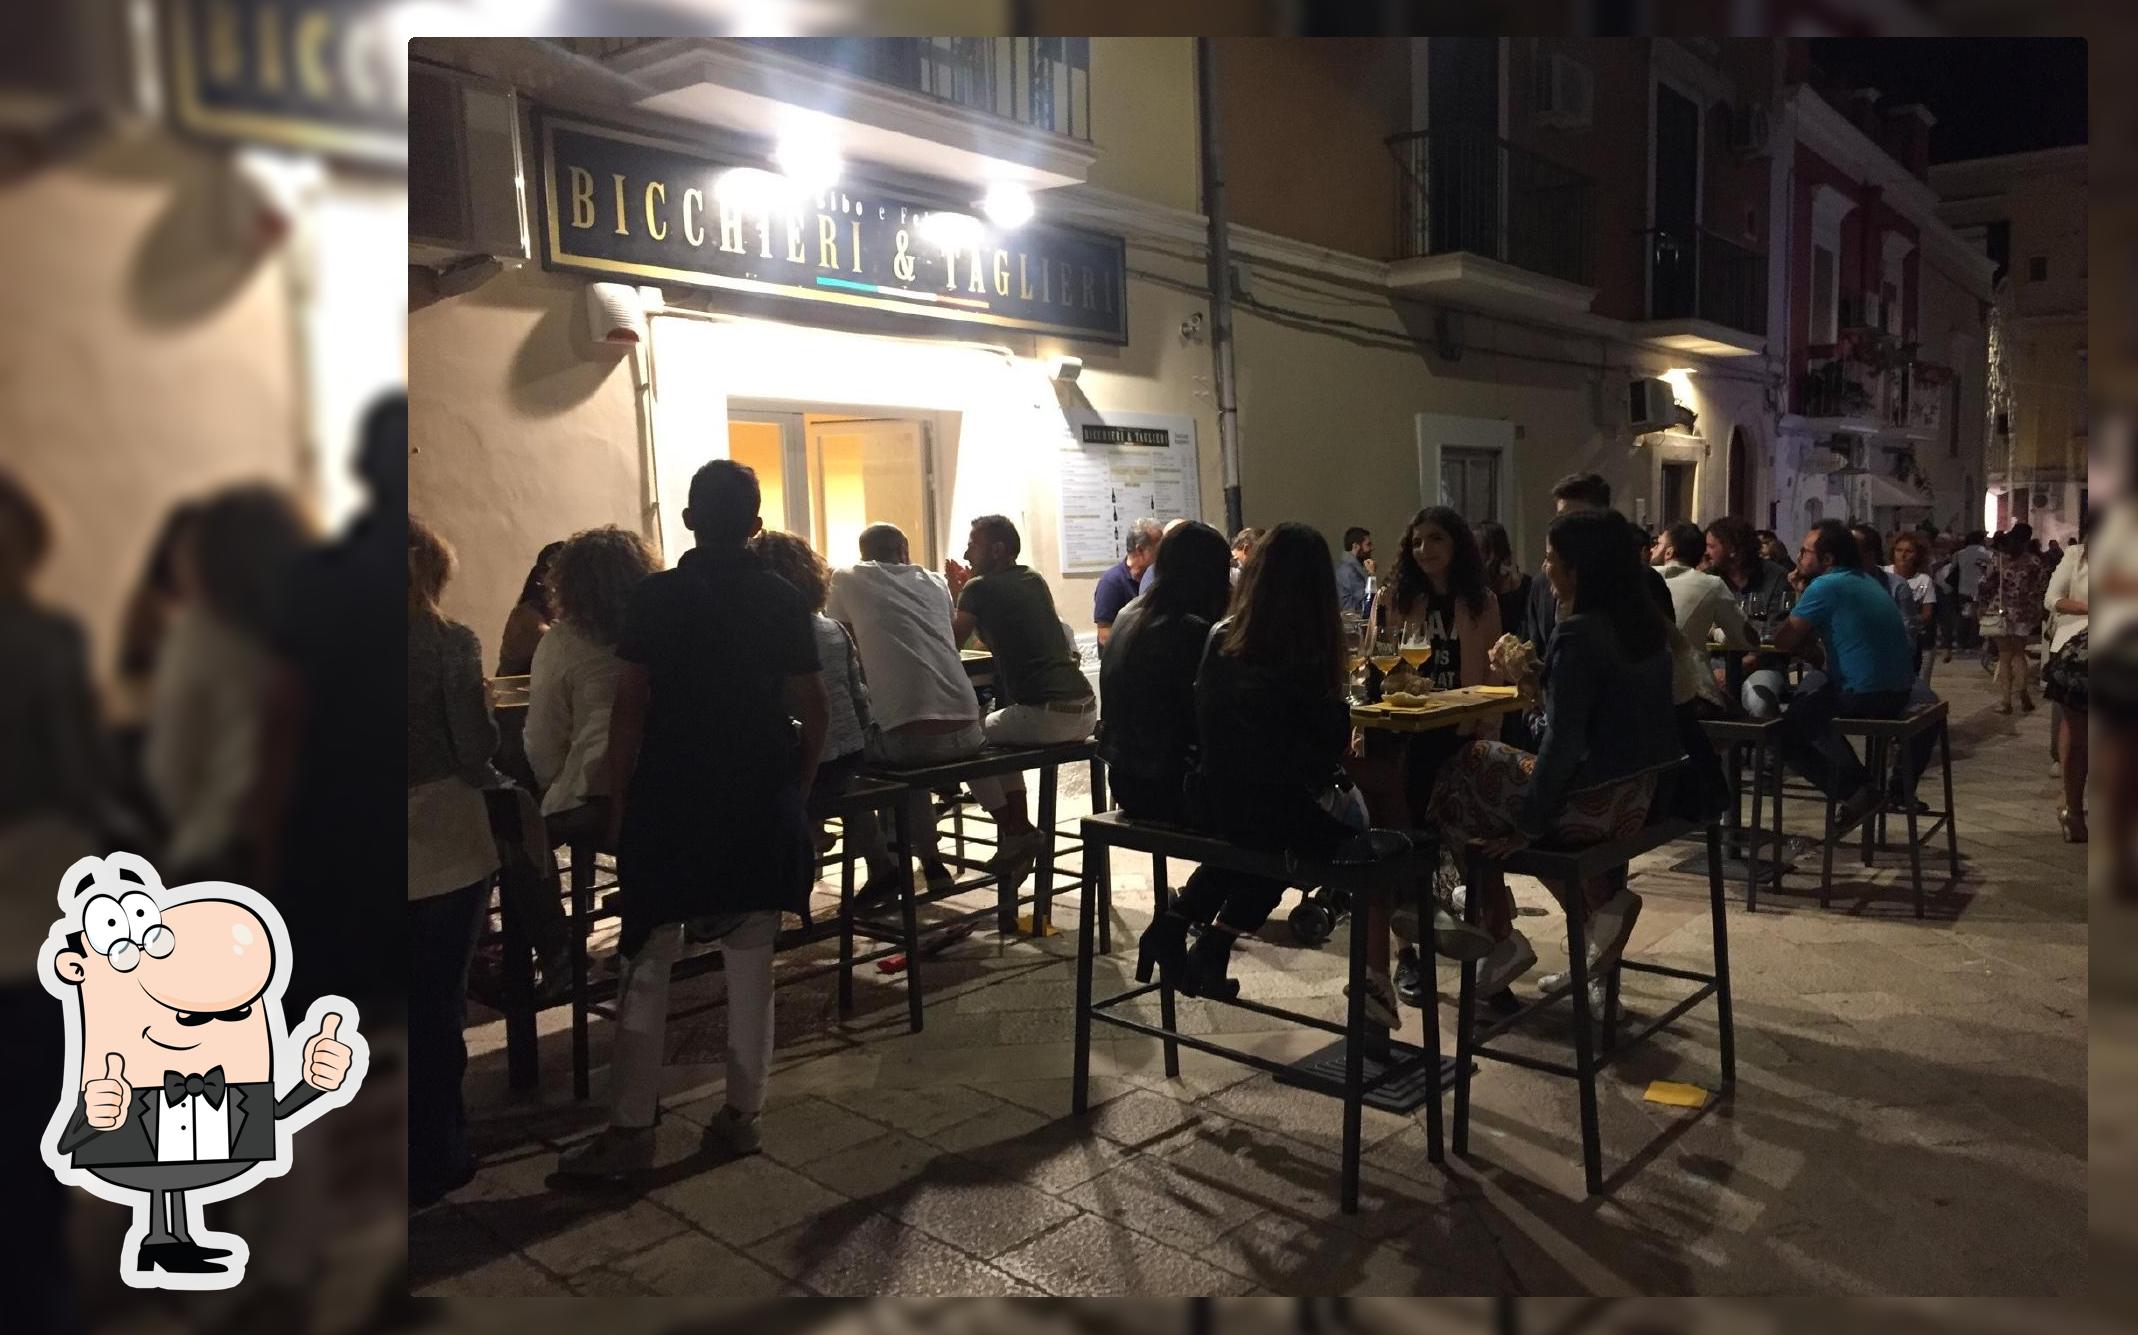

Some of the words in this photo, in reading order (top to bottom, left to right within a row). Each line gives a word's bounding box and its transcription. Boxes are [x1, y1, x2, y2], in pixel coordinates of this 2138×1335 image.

[568, 165, 864, 273] BICCHIERI
[893, 229, 916, 282] &
[940, 245, 1114, 315] TAGLIERI
